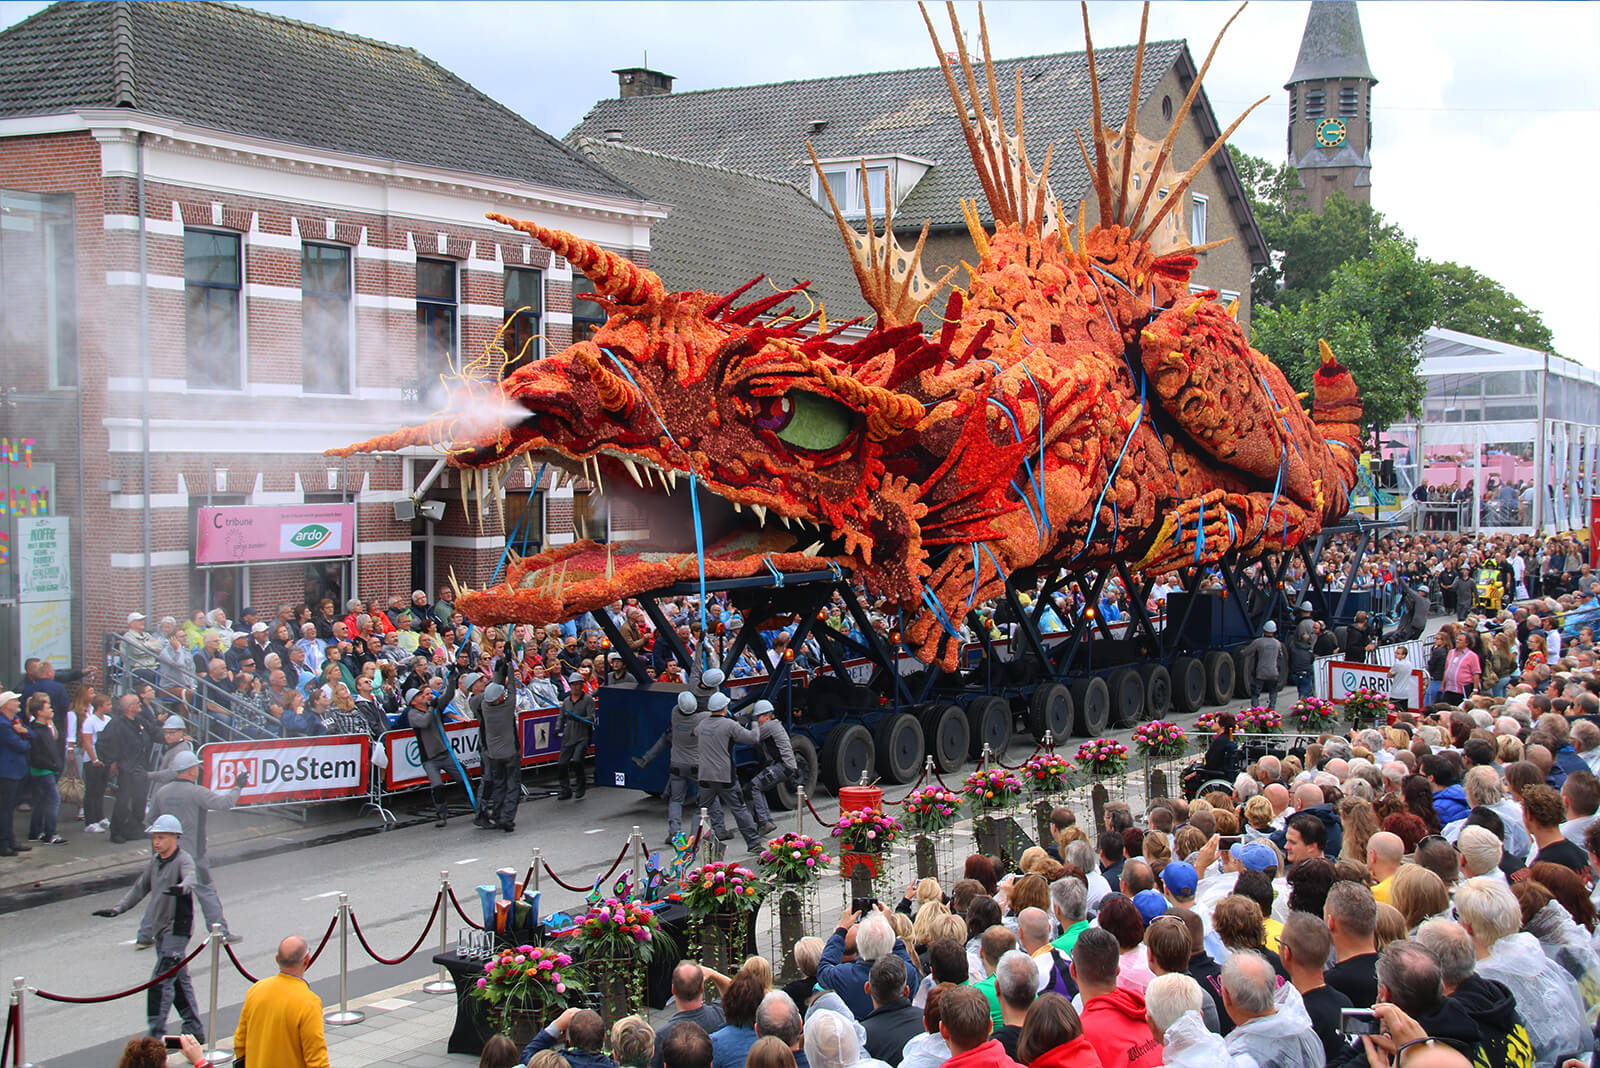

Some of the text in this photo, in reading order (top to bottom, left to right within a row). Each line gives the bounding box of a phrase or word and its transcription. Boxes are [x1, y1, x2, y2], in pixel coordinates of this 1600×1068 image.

[213, 512, 253, 529] C tribune
[295, 529, 322, 541] ardo
[262, 757, 356, 784] DeStem
